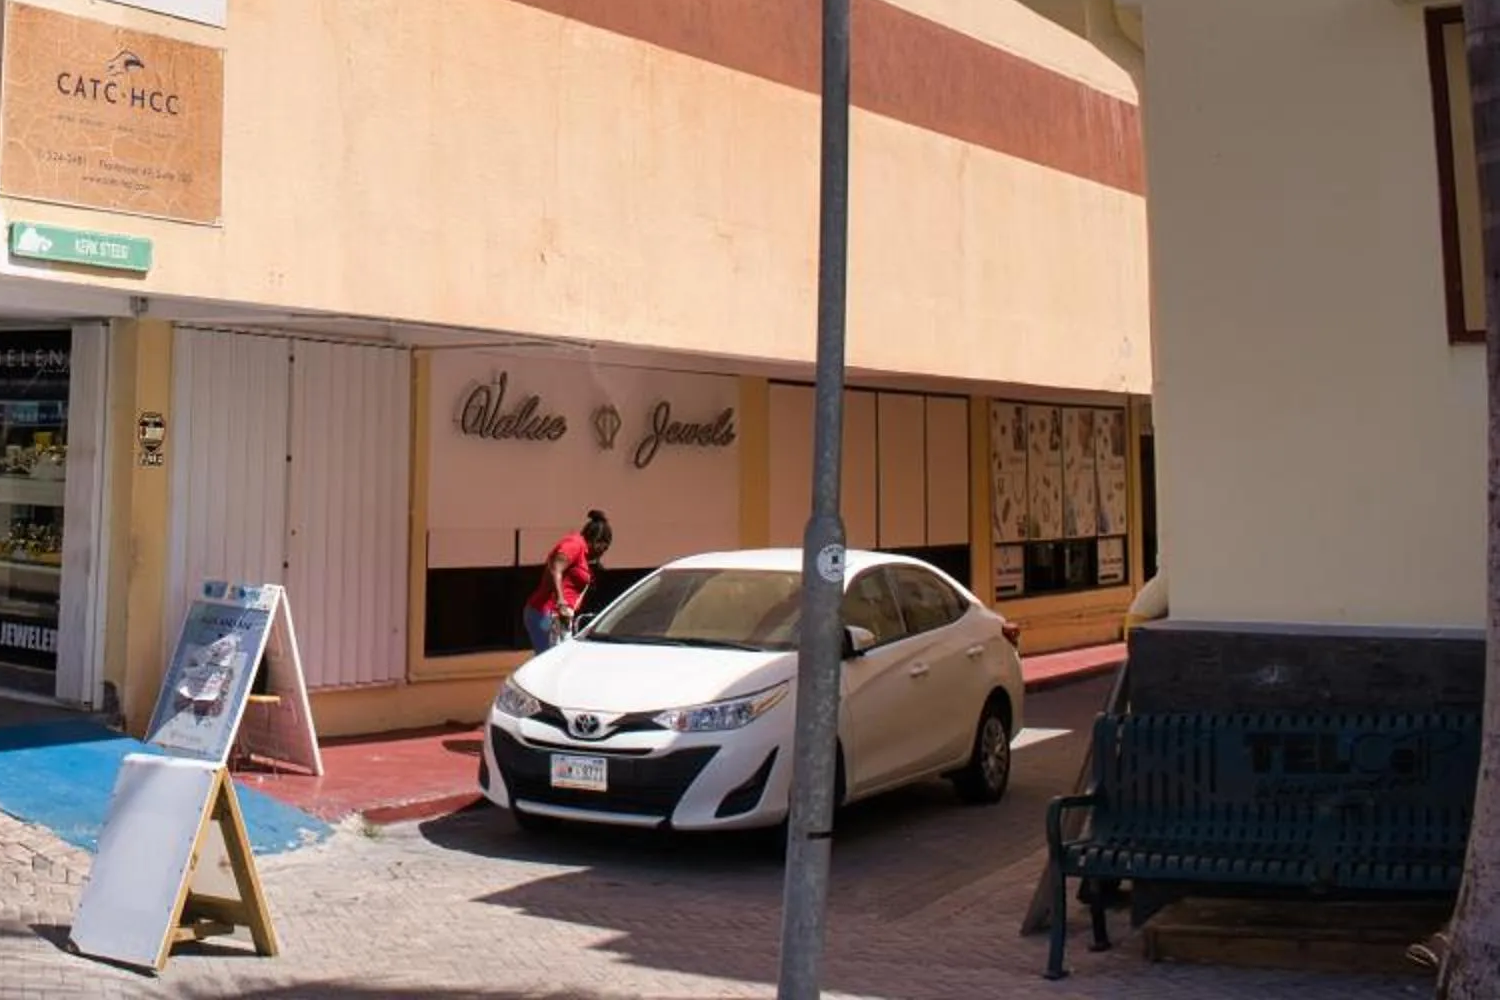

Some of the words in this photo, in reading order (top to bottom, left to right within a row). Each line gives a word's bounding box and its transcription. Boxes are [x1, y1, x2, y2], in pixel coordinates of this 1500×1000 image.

[461, 371, 568, 440] Value
[634, 401, 736, 469] Jewels
[0, 620, 58, 653] JEWELER
